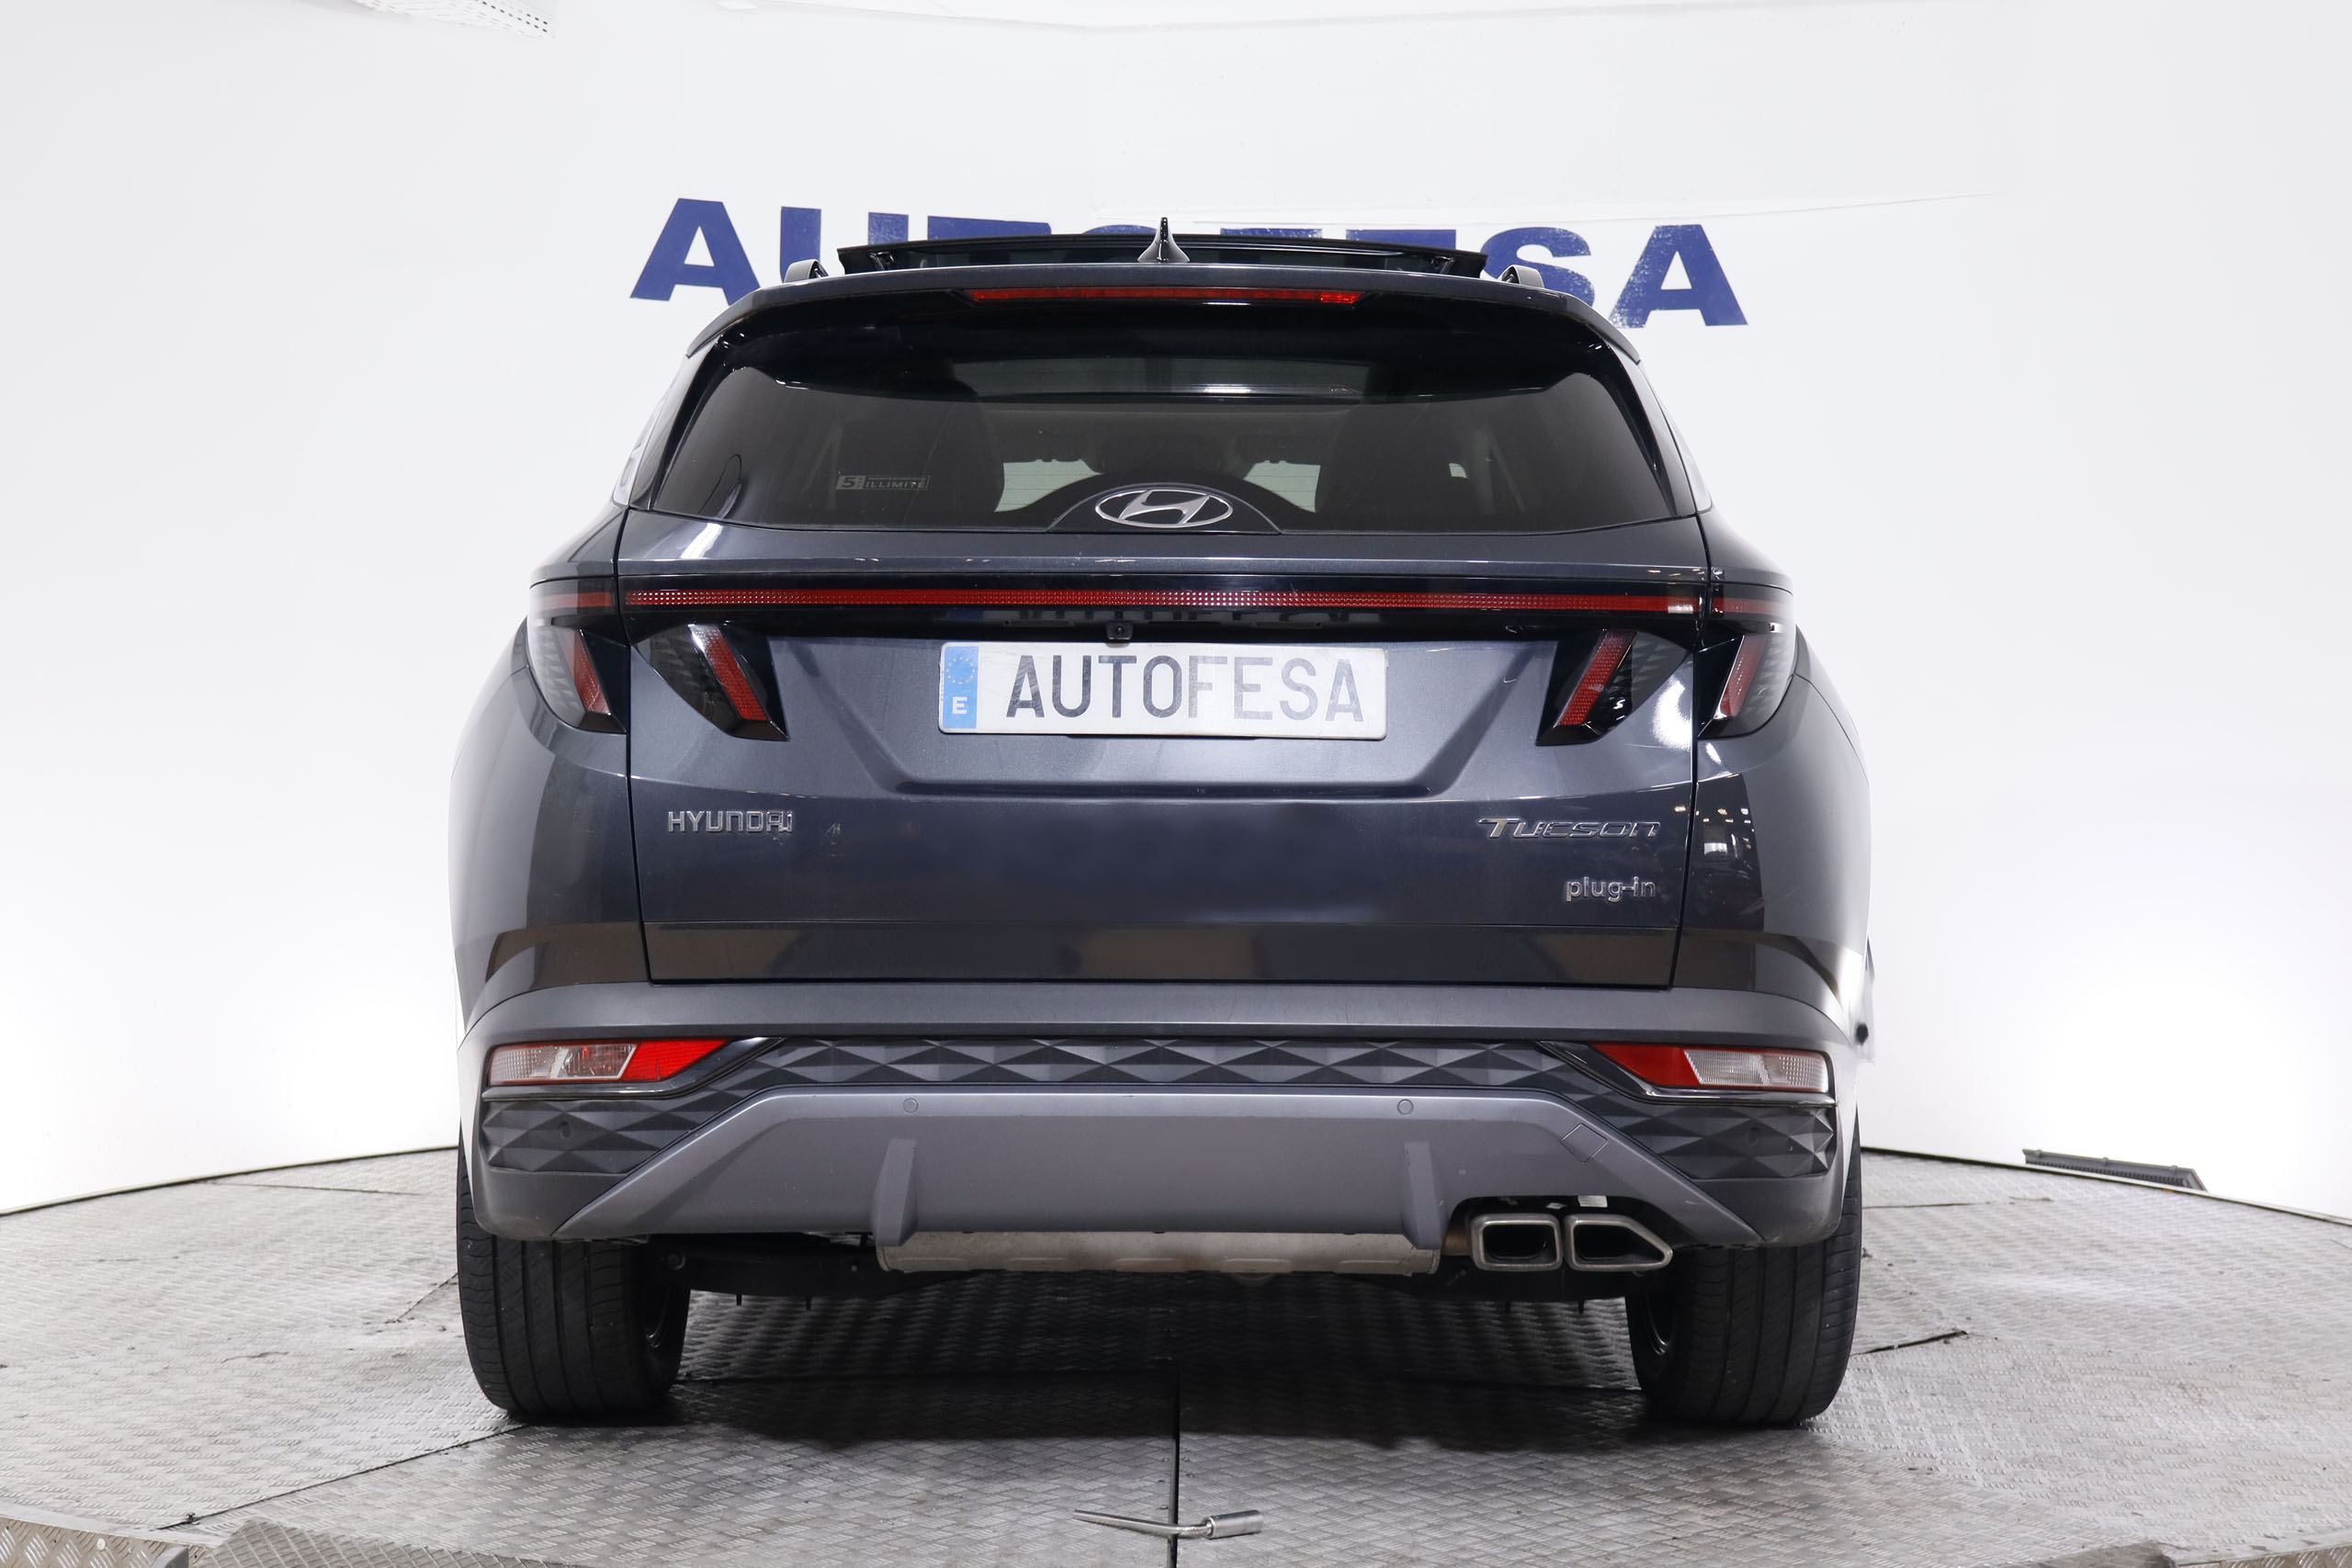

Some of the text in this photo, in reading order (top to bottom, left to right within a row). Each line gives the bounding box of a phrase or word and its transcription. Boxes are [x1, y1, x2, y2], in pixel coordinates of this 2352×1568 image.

[1005, 654, 1365, 723] AUTOFESA
[951, 695, 968, 716] E
[668, 810, 794, 832] HYUNDAI
[1477, 817, 1662, 839] TUCSON
[1565, 875, 1657, 902] plug-in
